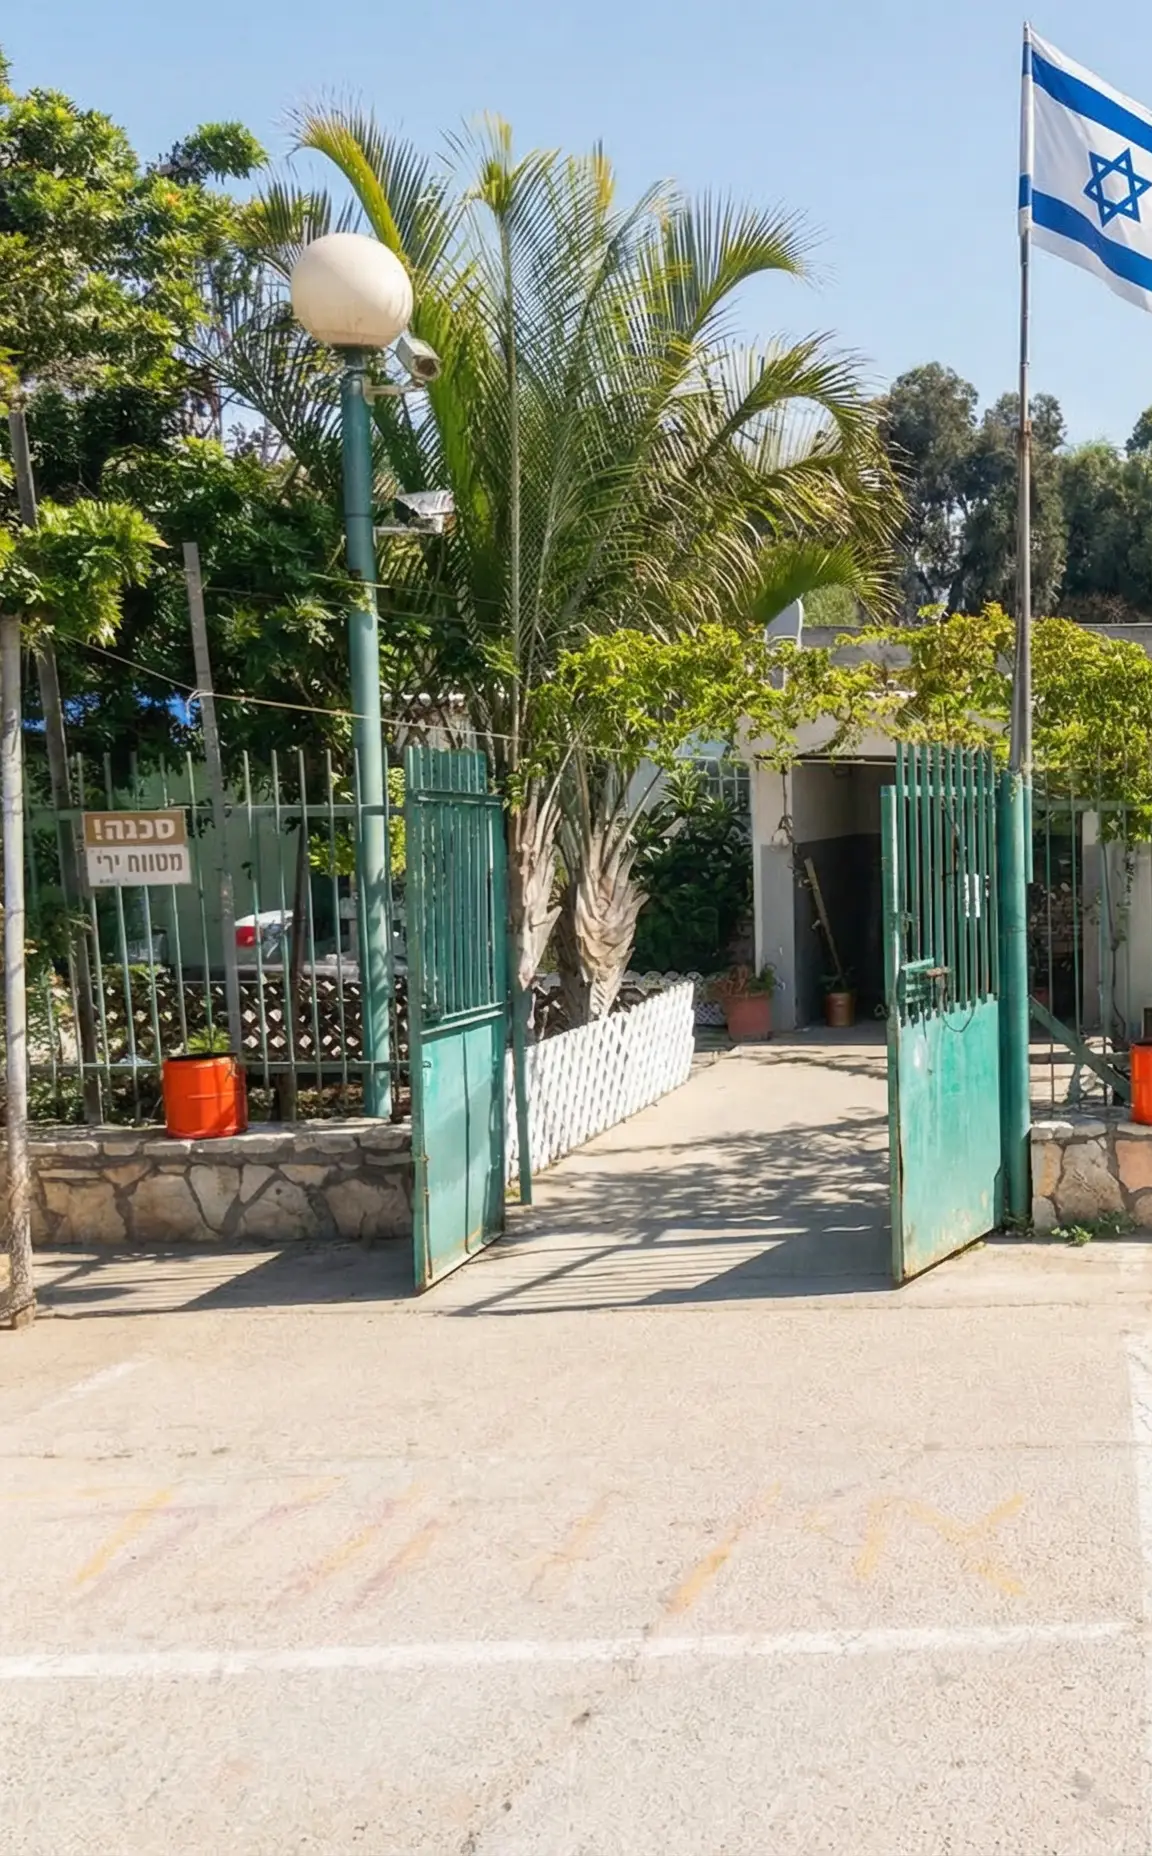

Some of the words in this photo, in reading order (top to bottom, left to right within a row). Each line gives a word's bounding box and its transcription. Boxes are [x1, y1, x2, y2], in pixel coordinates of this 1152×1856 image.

[93, 819, 176, 840] סכנה!
[96, 854, 120, 874] ירי
[127, 853, 183, 873] מטווח
